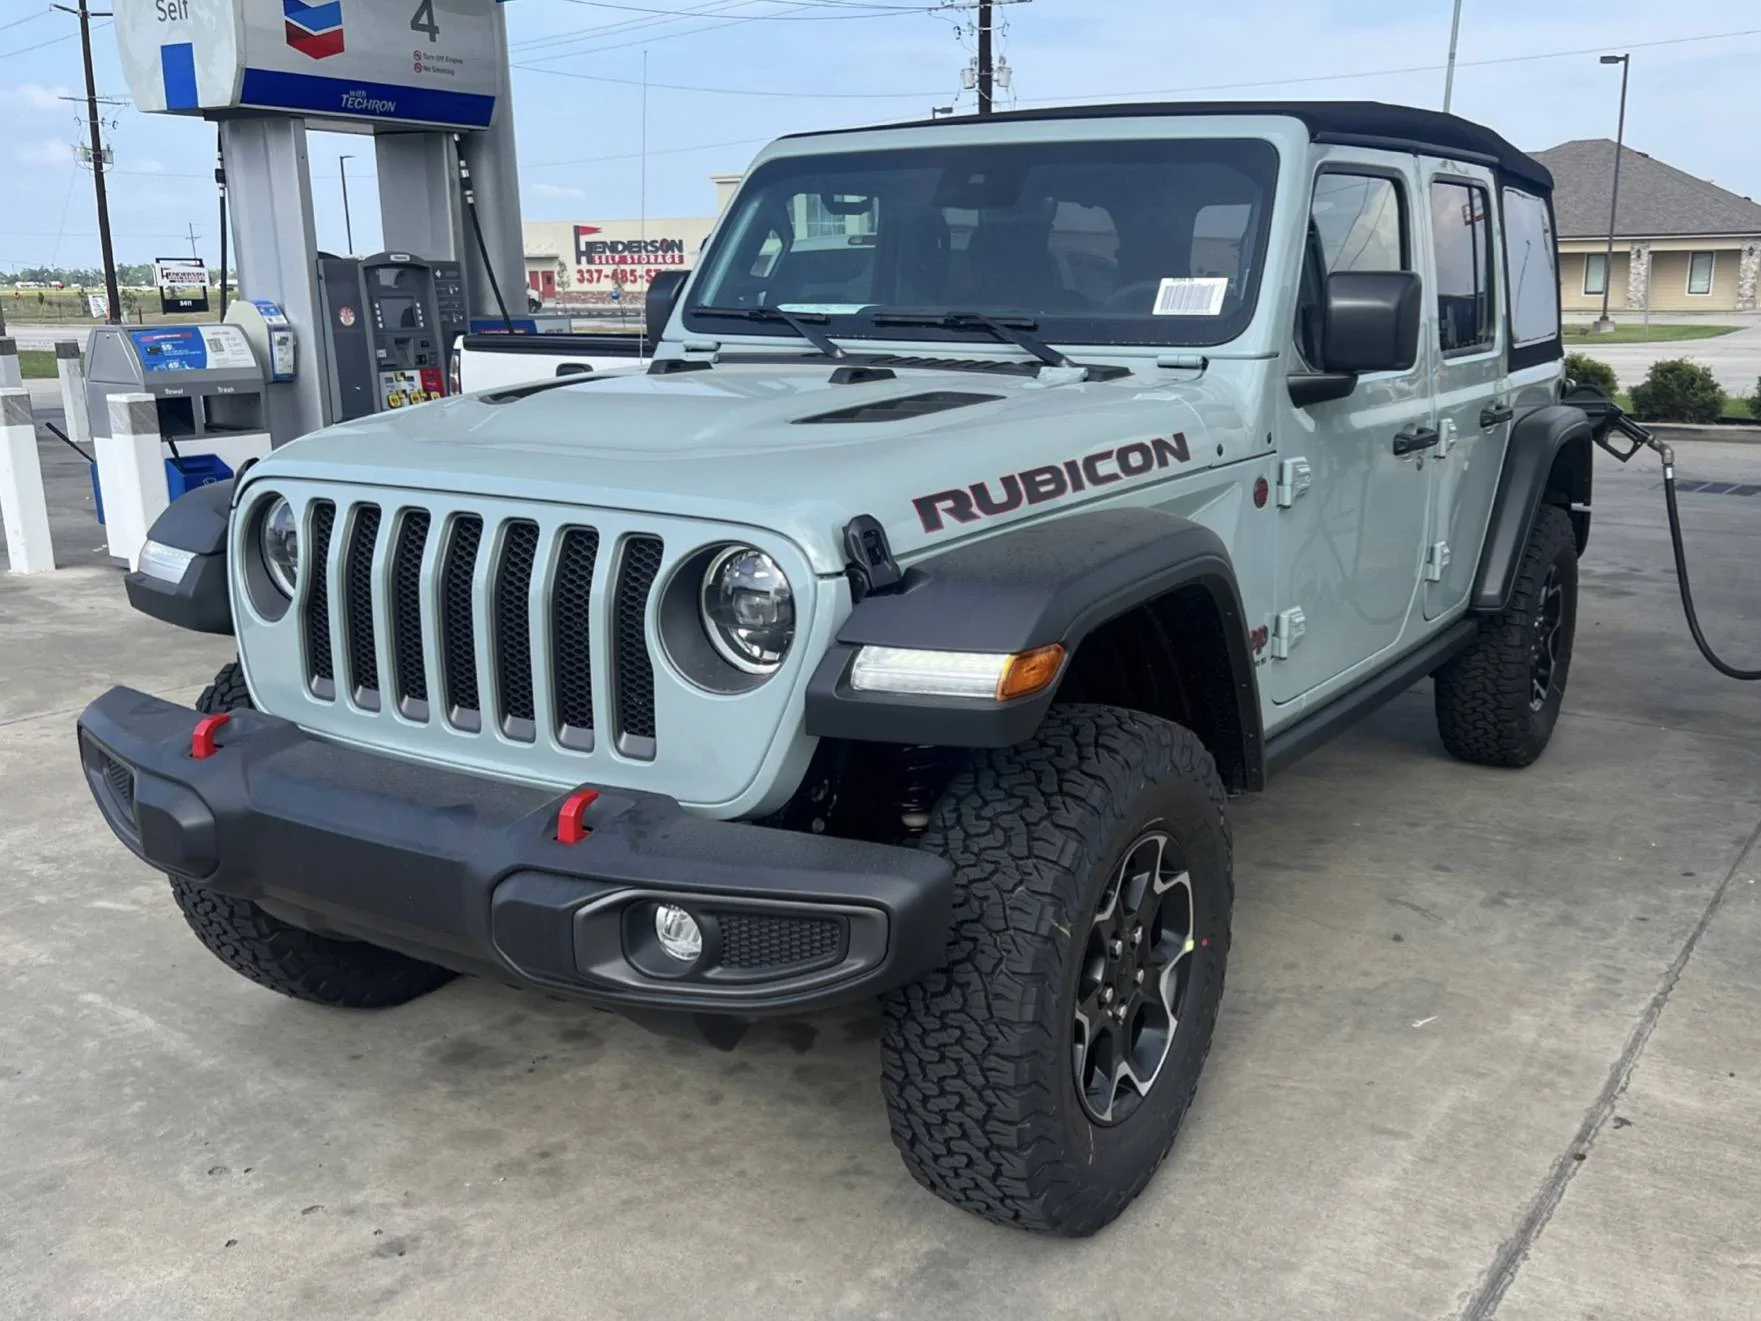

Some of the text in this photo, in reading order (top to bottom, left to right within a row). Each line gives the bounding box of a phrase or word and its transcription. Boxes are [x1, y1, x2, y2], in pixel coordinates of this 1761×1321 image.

[156, 0, 188, 22] Self
[411, 0, 440, 42] 4
[341, 94, 397, 114] TECHRON
[573, 225, 684, 265] HENDERSON
[594, 255, 681, 264] SELF STORAGE
[912, 432, 1191, 533] RUBICON
